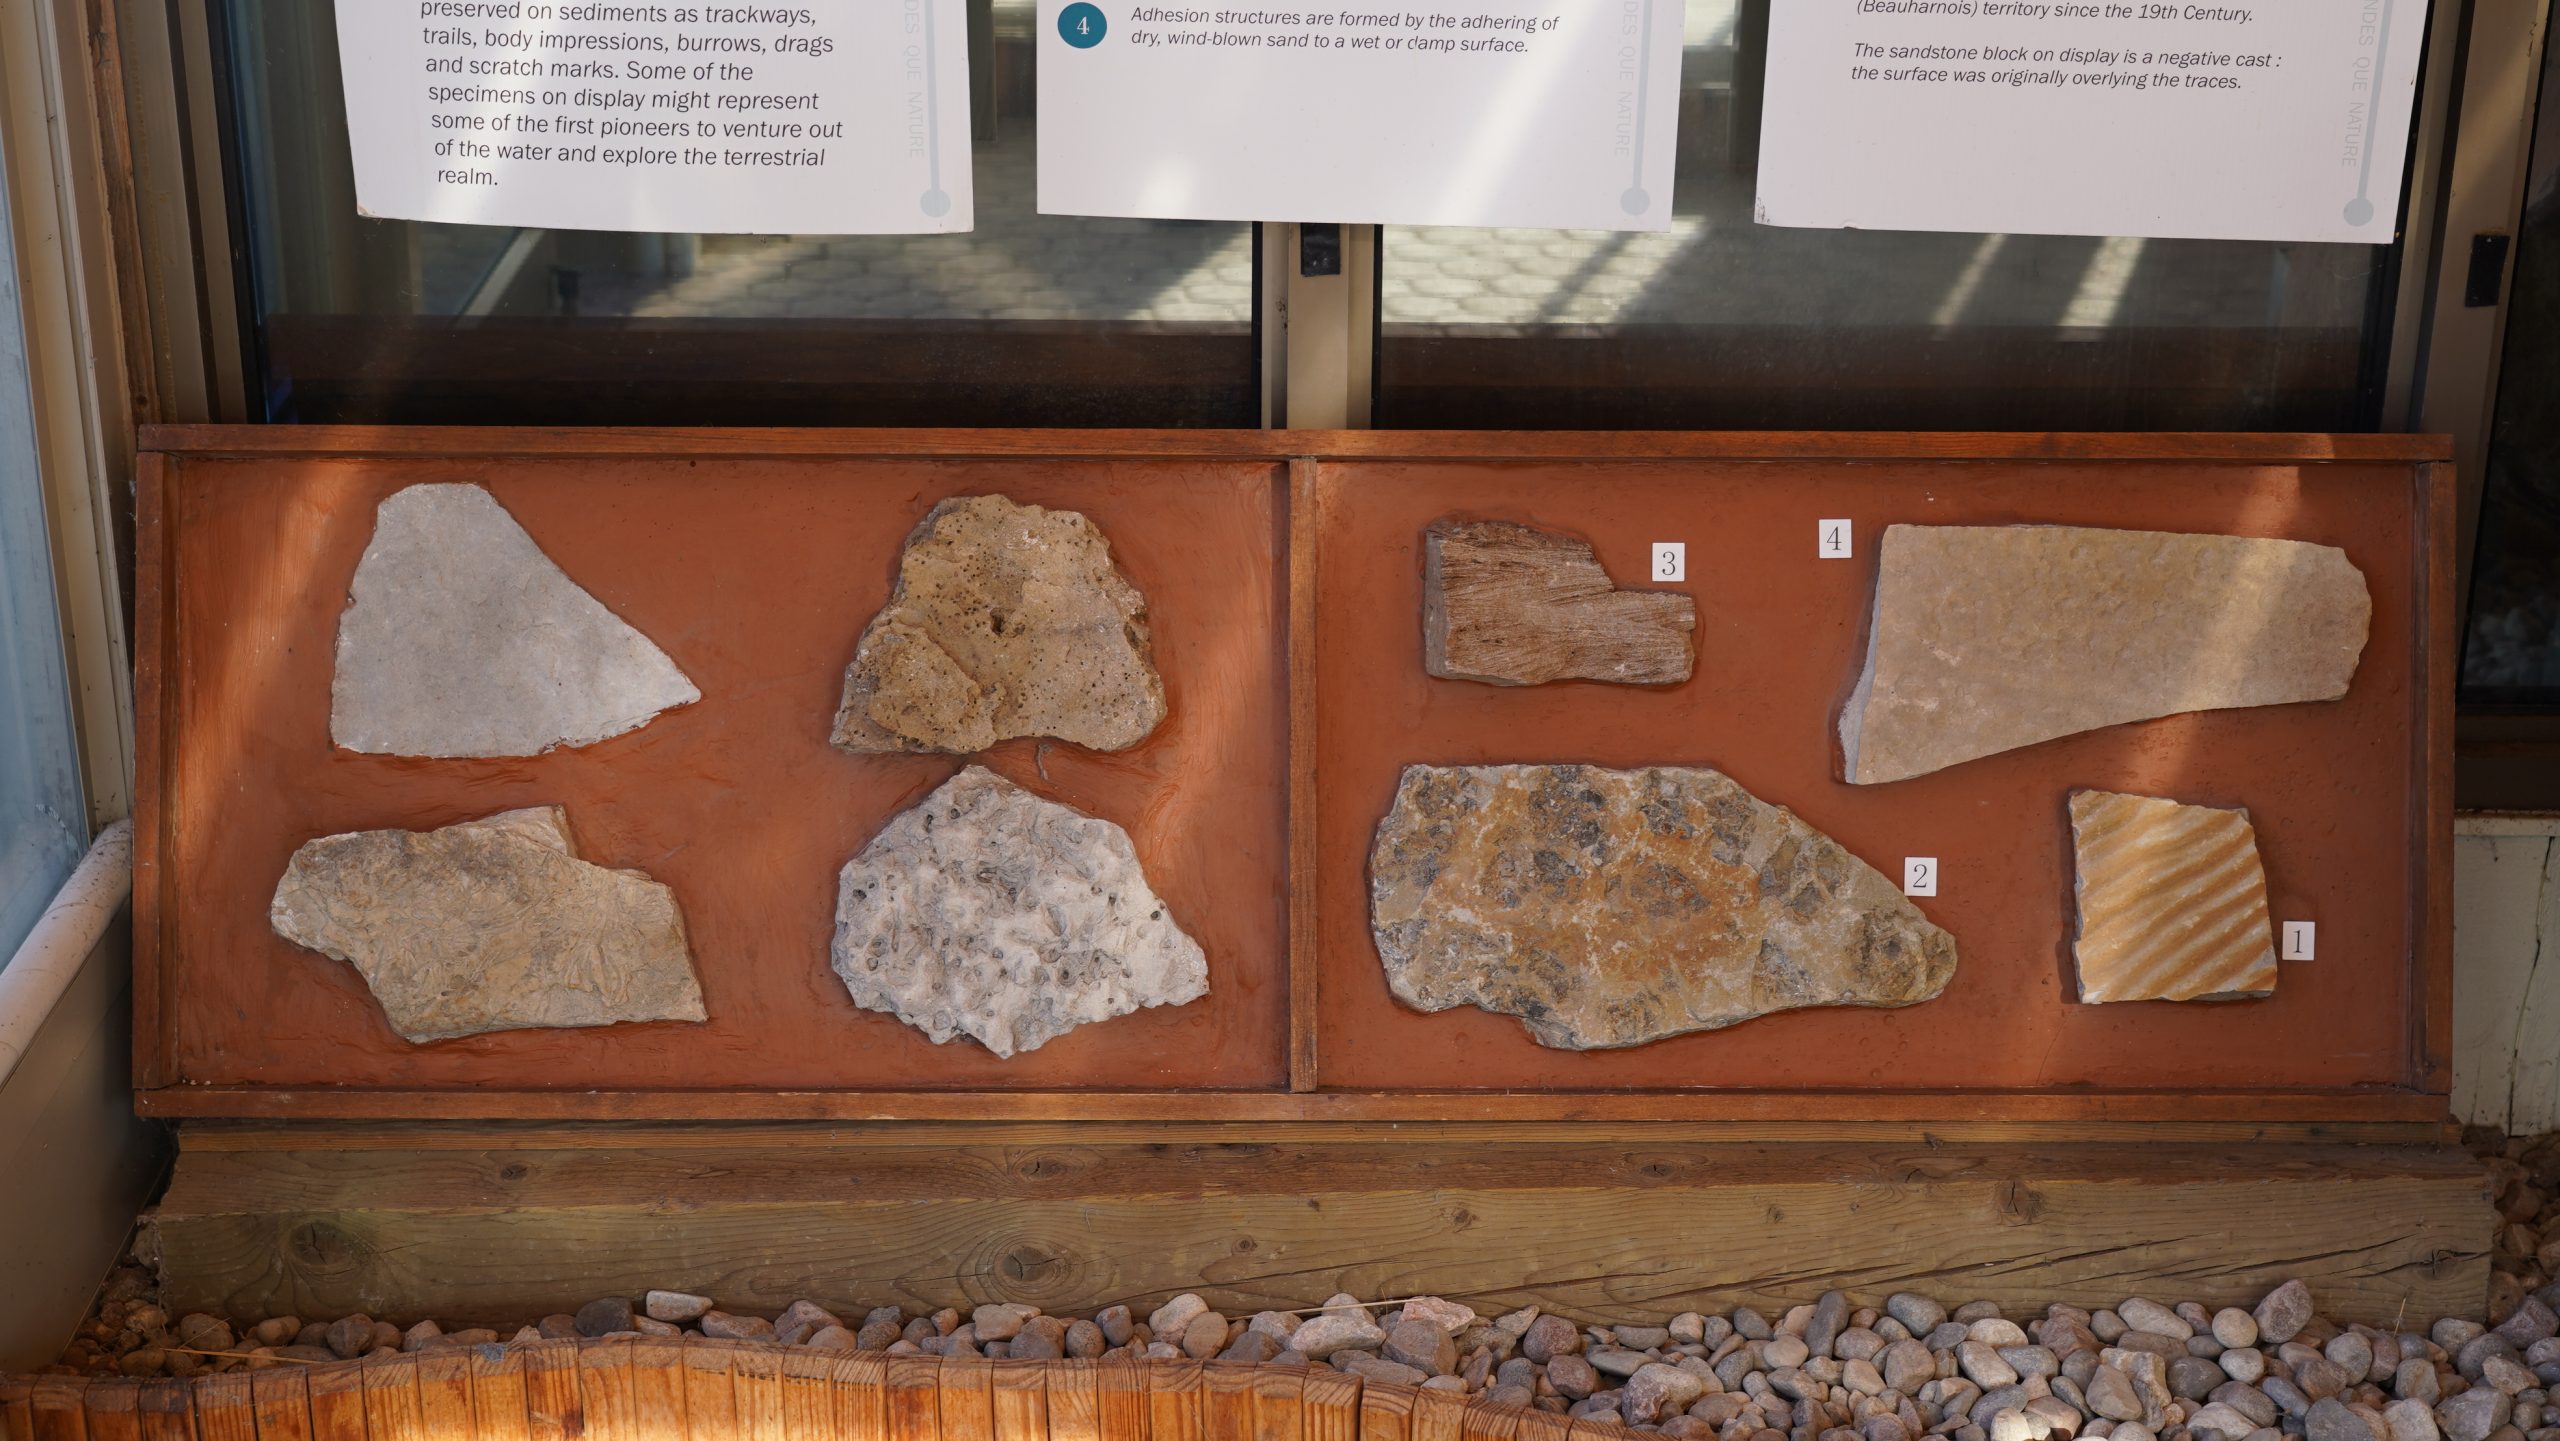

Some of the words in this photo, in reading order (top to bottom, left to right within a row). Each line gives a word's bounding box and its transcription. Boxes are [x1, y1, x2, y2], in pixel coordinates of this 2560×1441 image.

[421, 0, 521, 20] preserved
[527, 4, 552, 20] on
[559, 3, 668, 23] sediments
[674, 8, 699, 23] as
[706, 5, 816, 28] trackways,
[1076, 16, 1090, 35] 4
[1131, 6, 1210, 23] Adhesion
[1215, 10, 1301, 26] structures
[1305, 13, 1335, 26] are
[1340, 11, 1401, 27] formed
[1404, 13, 1425, 31] by
[1429, 14, 1457, 29] the
[1461, 15, 1538, 34] adhering
[1542, 16, 1561, 31] of
[1857, 0, 1978, 18] (Beauharnois)
[1983, 1, 2051, 20] territory
[2053, 3, 2100, 18] since
[2105, 3, 2133, 19] the
[2138, 4, 2178, 20] 19th
[2184, 5, 2253, 25] Century.
[423, 27, 477, 49] trails,
[485, 29, 534, 52] body
[540, 31, 669, 55] impressions,
[677, 33, 767, 56] burrows,
[775, 34, 834, 58] drags
[1131, 29, 1161, 48] dry,
[1168, 31, 1262, 47] wind-blown
[1267, 34, 1310, 48] sand
[1314, 34, 1330, 49] to
[1335, 37, 1345, 49] a
[1351, 36, 1381, 50] wet
[1385, 38, 1403, 51] or
[1408, 36, 1456, 54] damp
[1460, 37, 1529, 53] surface.
[426, 56, 464, 74] and
[469, 58, 543, 77] scratch
[551, 60, 619, 79] marks.
[627, 61, 687, 81] Some
[693, 62, 714, 81] of
[719, 64, 754, 81] the
[904, 45, 922, 81] QUE
[1618, 46, 1637, 81] QUE
[1855, 43, 1885, 59] The
[1889, 45, 1978, 61] sandstone
[1983, 46, 2030, 62] block
[2033, 50, 2055, 63] on
[2060, 47, 2120, 67] display
[2124, 50, 2138, 64] is
[2142, 53, 2153, 65] a
[2158, 50, 2231, 70] negative
[2236, 53, 2273, 68] cast
[1852, 65, 1879, 81] the
[1883, 66, 1948, 82] surface
[1953, 71, 1987, 83] was
[1991, 68, 2069, 88] originally
[2072, 71, 2150, 91] overlying
[2153, 73, 2180, 88] the
[2185, 74, 2242, 89] traces.
[2351, 57, 2370, 92] QUE
[428, 85, 536, 105] specimens
[543, 91, 567, 106] on
[574, 88, 646, 112] display
[652, 90, 711, 114] might
[718, 93, 820, 114] represent
[431, 115, 485, 131] some
[492, 113, 512, 132] of
[517, 114, 549, 134] the
[555, 116, 595, 135] first
[601, 119, 690, 140] pioneers
[697, 121, 717, 138] to
[724, 121, 803, 139] venture
[809, 122, 844, 139] out
[908, 92, 924, 158] NATURE
[1614, 91, 1633, 158] NATURE
[2342, 102, 2364, 168] NATURE
[435, 139, 455, 158] of
[459, 140, 490, 159] the
[497, 144, 553, 161] water
[558, 145, 597, 163] and
[603, 146, 678, 168] explore
[684, 147, 718, 166] the
[724, 148, 825, 167] terrestrial
[437, 167, 499, 186] realm.
[1826, 525, 1842, 551] 4
[1661, 551, 1677, 576] 3
[1912, 863, 1928, 889] 2
[2293, 929, 2304, 954] 1
